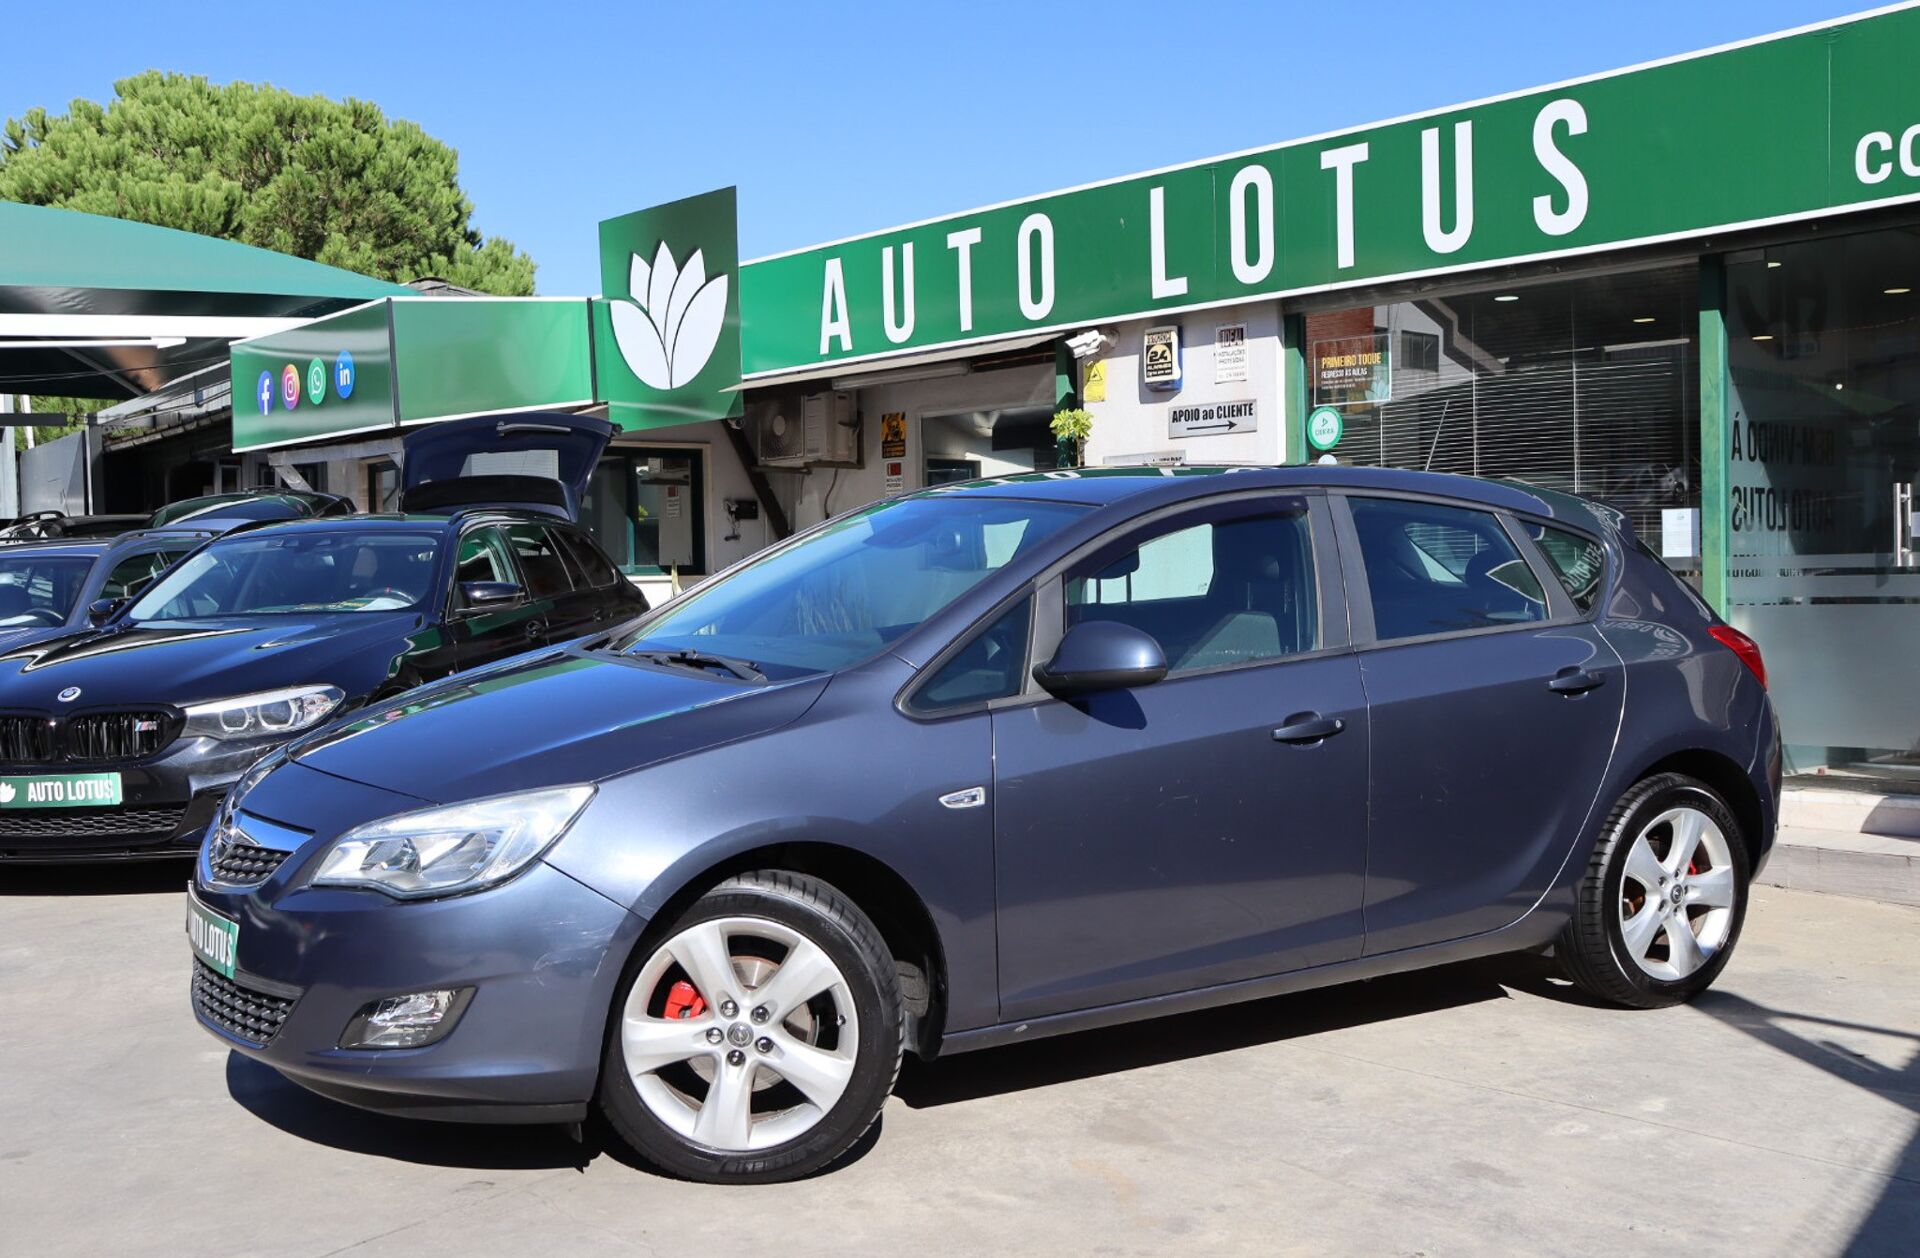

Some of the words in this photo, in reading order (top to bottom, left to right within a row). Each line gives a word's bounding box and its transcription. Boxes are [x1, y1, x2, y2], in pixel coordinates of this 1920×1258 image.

[819, 213, 1055, 356] AUTO
[1150, 98, 1590, 300] LOTUS
[1149, 350, 1168, 362] 24
[1321, 355, 1357, 369] PRIMEIRO
[1358, 352, 1382, 366] TOQUE
[1172, 408, 1200, 423] APOIO
[1202, 409, 1214, 421] ao
[1216, 403, 1253, 419] CLIENTE
[28, 781, 64, 802] AUTO
[67, 779, 114, 800] LOTUS
[204, 921, 233, 968] LOTUS
